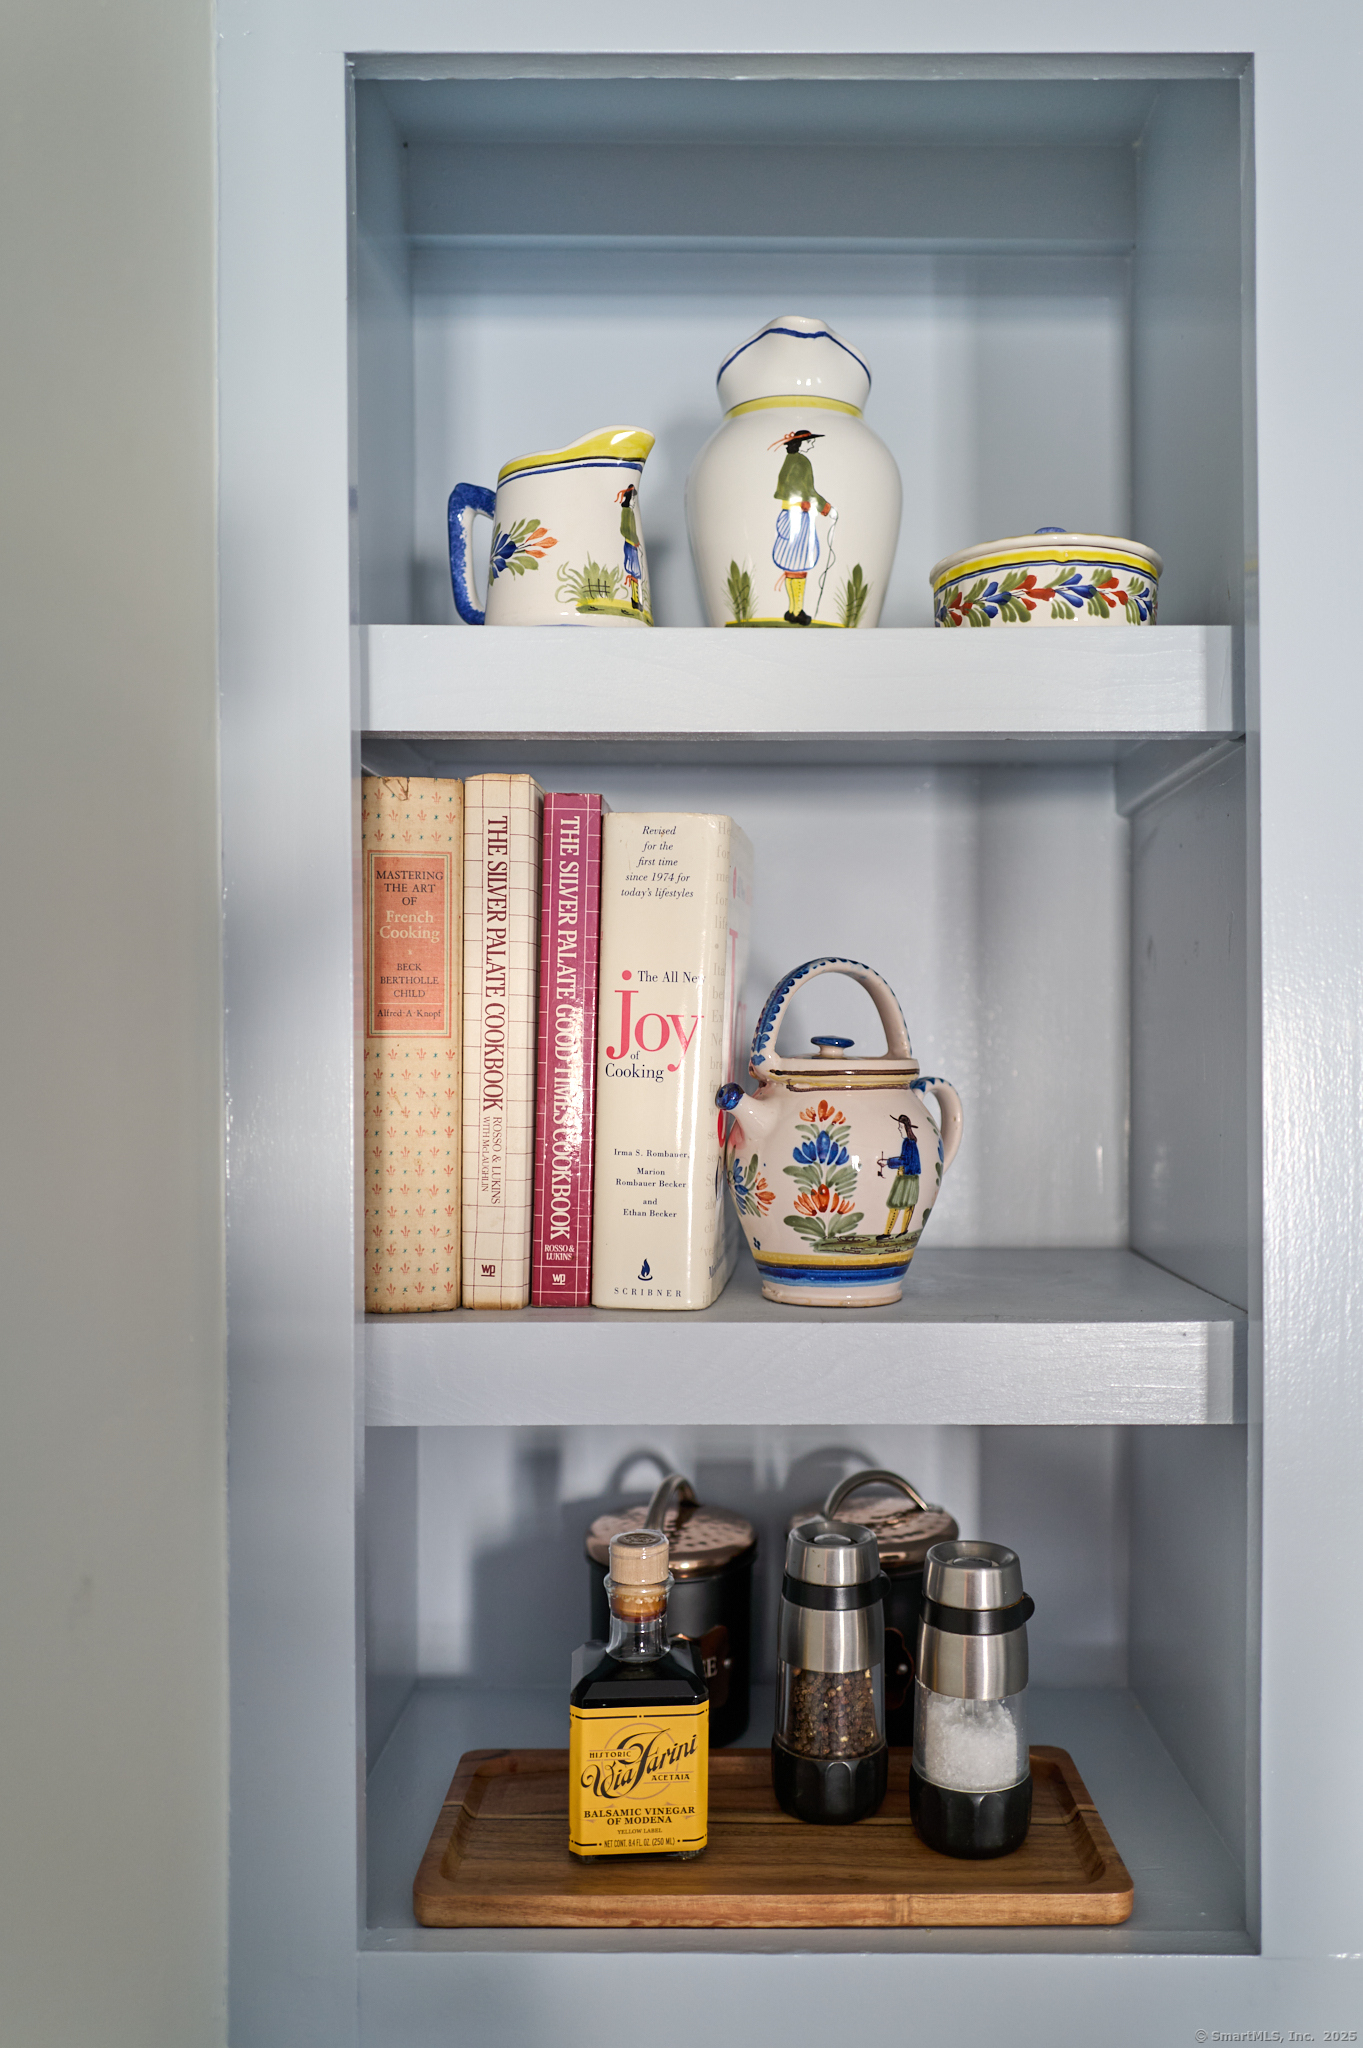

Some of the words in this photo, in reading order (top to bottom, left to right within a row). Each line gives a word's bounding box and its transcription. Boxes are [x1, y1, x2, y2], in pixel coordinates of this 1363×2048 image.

[487, 815, 508, 856] THE
[560, 815, 581, 856] THE
[642, 826, 677, 836] Revised
[641, 841, 657, 852] for
[659, 841, 674, 851] the
[636, 857, 656, 868] first
[658, 857, 679, 867] time
[376, 870, 444, 880] MASTERING
[625, 872, 648, 881] since
[651, 872, 675, 882] 1974
[675, 873, 691, 884] for
[384, 883, 408, 893] THE
[412, 883, 436, 893] ART
[486, 860, 508, 923] SILVER
[558, 860, 580, 926] SILVER
[620, 888, 652, 899] today's
[655, 888, 694, 900] lifestyles
[401, 896, 418, 906] OF
[386, 910, 434, 923] French
[379, 925, 440, 944] Cooking
[396, 963, 422, 971] BECK
[485, 928, 507, 998] PALATE
[556, 930, 578, 1000] PALATE
[380, 976, 440, 985] BERTHOLLE
[638, 970, 659, 983] The
[661, 971, 678, 983] All
[393, 989, 426, 998] CHILD
[606, 970, 705, 1072] Joy
[554, 1003, 576, 1061] GOOD
[483, 1002, 506, 1112] COOKBOOK
[630, 1050, 641, 1060] of
[605, 1062, 664, 1083] Cooking
[552, 1066, 574, 1125] TIMES
[482, 1116, 490, 1138] WITH
[491, 1116, 503, 1152] ROSSO
[491, 1154, 502, 1163] &
[614, 1148, 633, 1157] Irma
[635, 1149, 643, 1157] S.
[646, 1149, 690, 1159] Rombauer,
[481, 1139, 490, 1192] McLAUGHLIN
[636, 1167, 666, 1176] Marion
[490, 1166, 502, 1205] LUKINS
[550, 1128, 574, 1240] COOKBOOK
[615, 1178, 657, 1188] Rombauer
[658, 1180, 687, 1188] Becker
[623, 1208, 647, 1217] Ethan
[649, 1209, 678, 1218] Becker
[544, 1244, 568, 1253] ROSSO
[568, 1244, 575, 1253] &
[546, 1252, 573, 1261] LUKINS
[614, 1287, 682, 1298] SCRIBNER
[651, 1773, 690, 1781] ACETAIA
[584, 1808, 642, 1818] BALSAMIC
[644, 1806, 696, 1816] VINEGAR
[606, 1818, 621, 1826] OF
[624, 1816, 672, 1825] MODENA
[604, 1840, 613, 1848] NET
[614, 1839, 628, 1848] CONT.
[651, 1837, 665, 1847] (250
[665, 1837, 676, 1846] ML)
